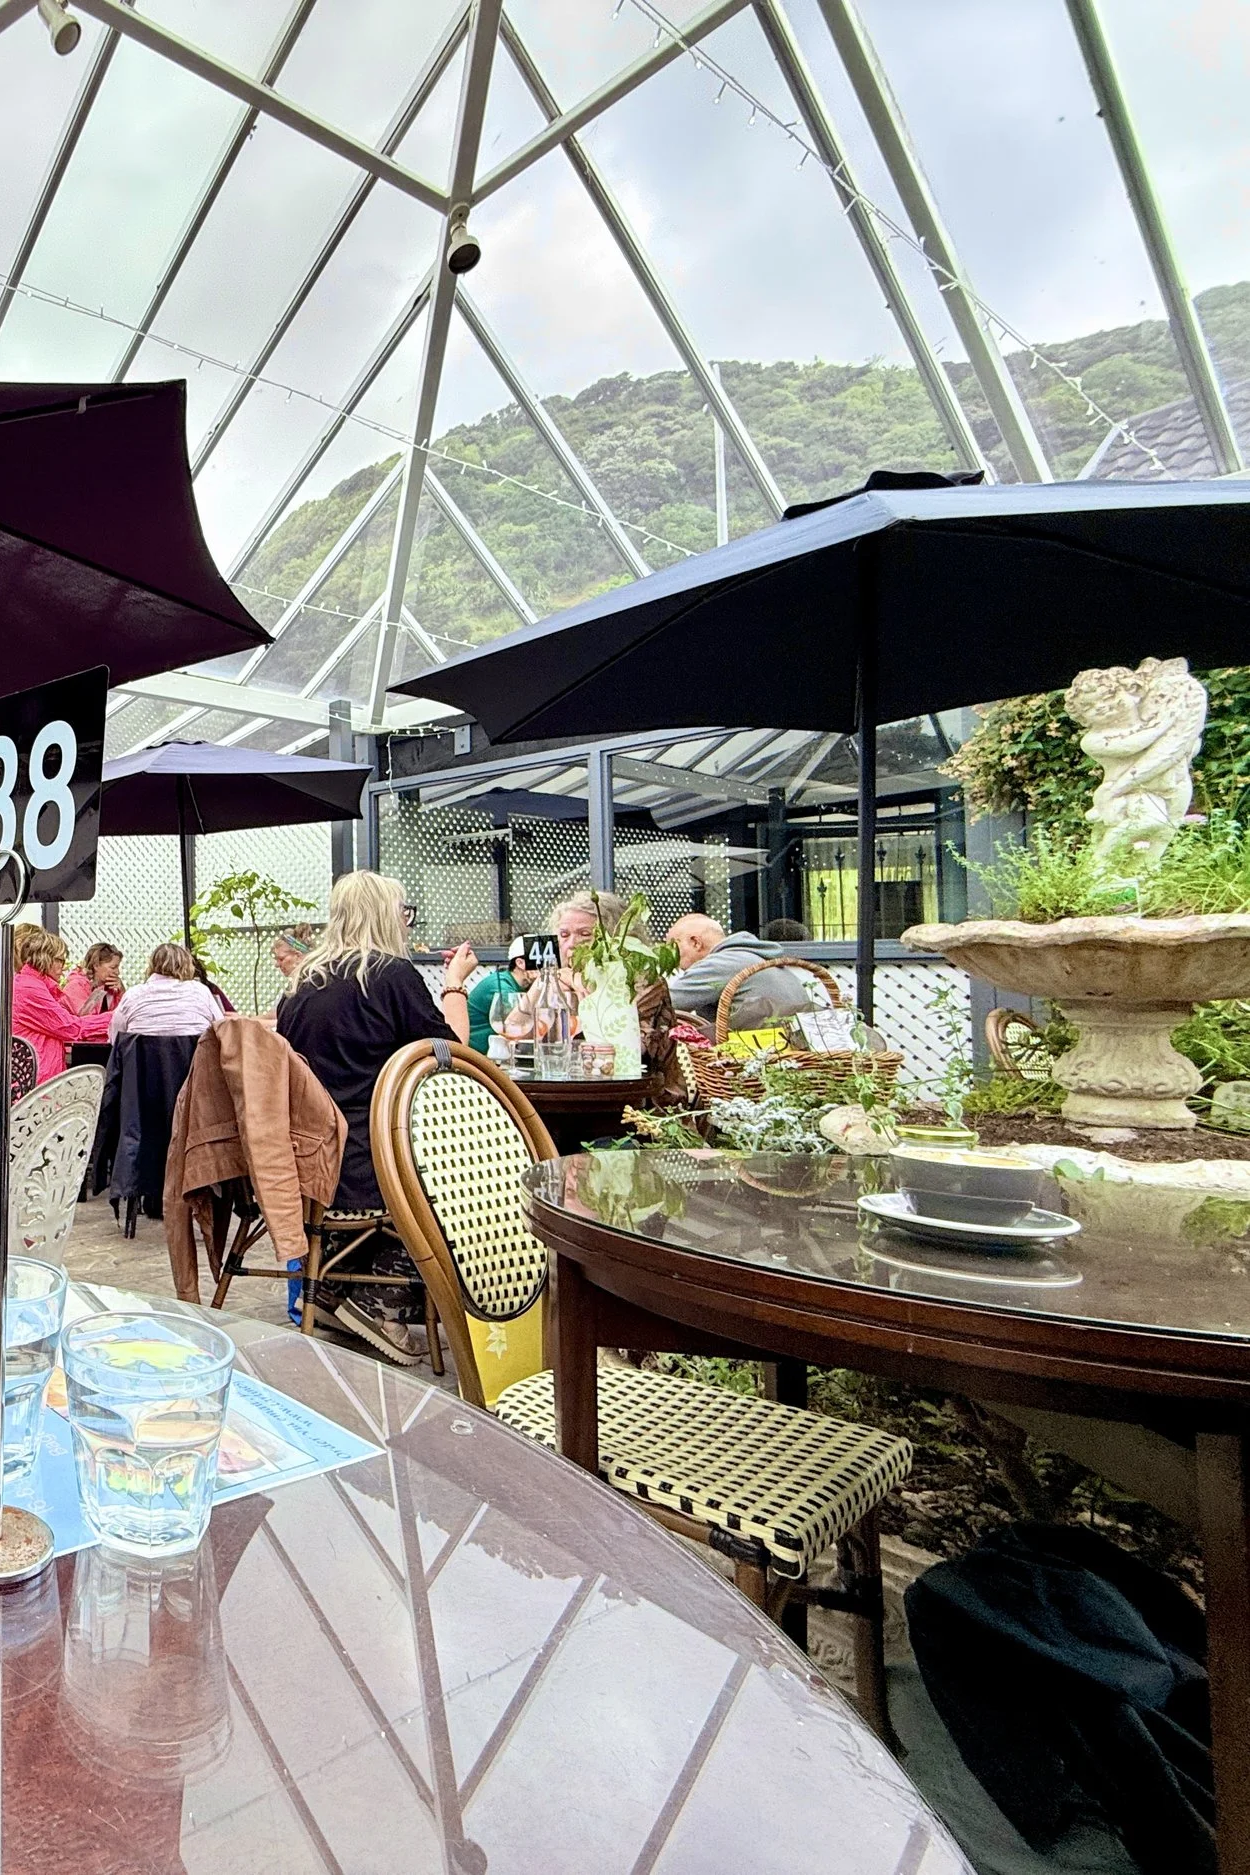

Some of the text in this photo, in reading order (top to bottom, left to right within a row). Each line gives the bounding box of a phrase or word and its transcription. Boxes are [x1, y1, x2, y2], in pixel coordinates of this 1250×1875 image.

[529, 941, 557, 965] 44
[286, 1421, 309, 1437] via
[308, 1436, 352, 1460] Order
